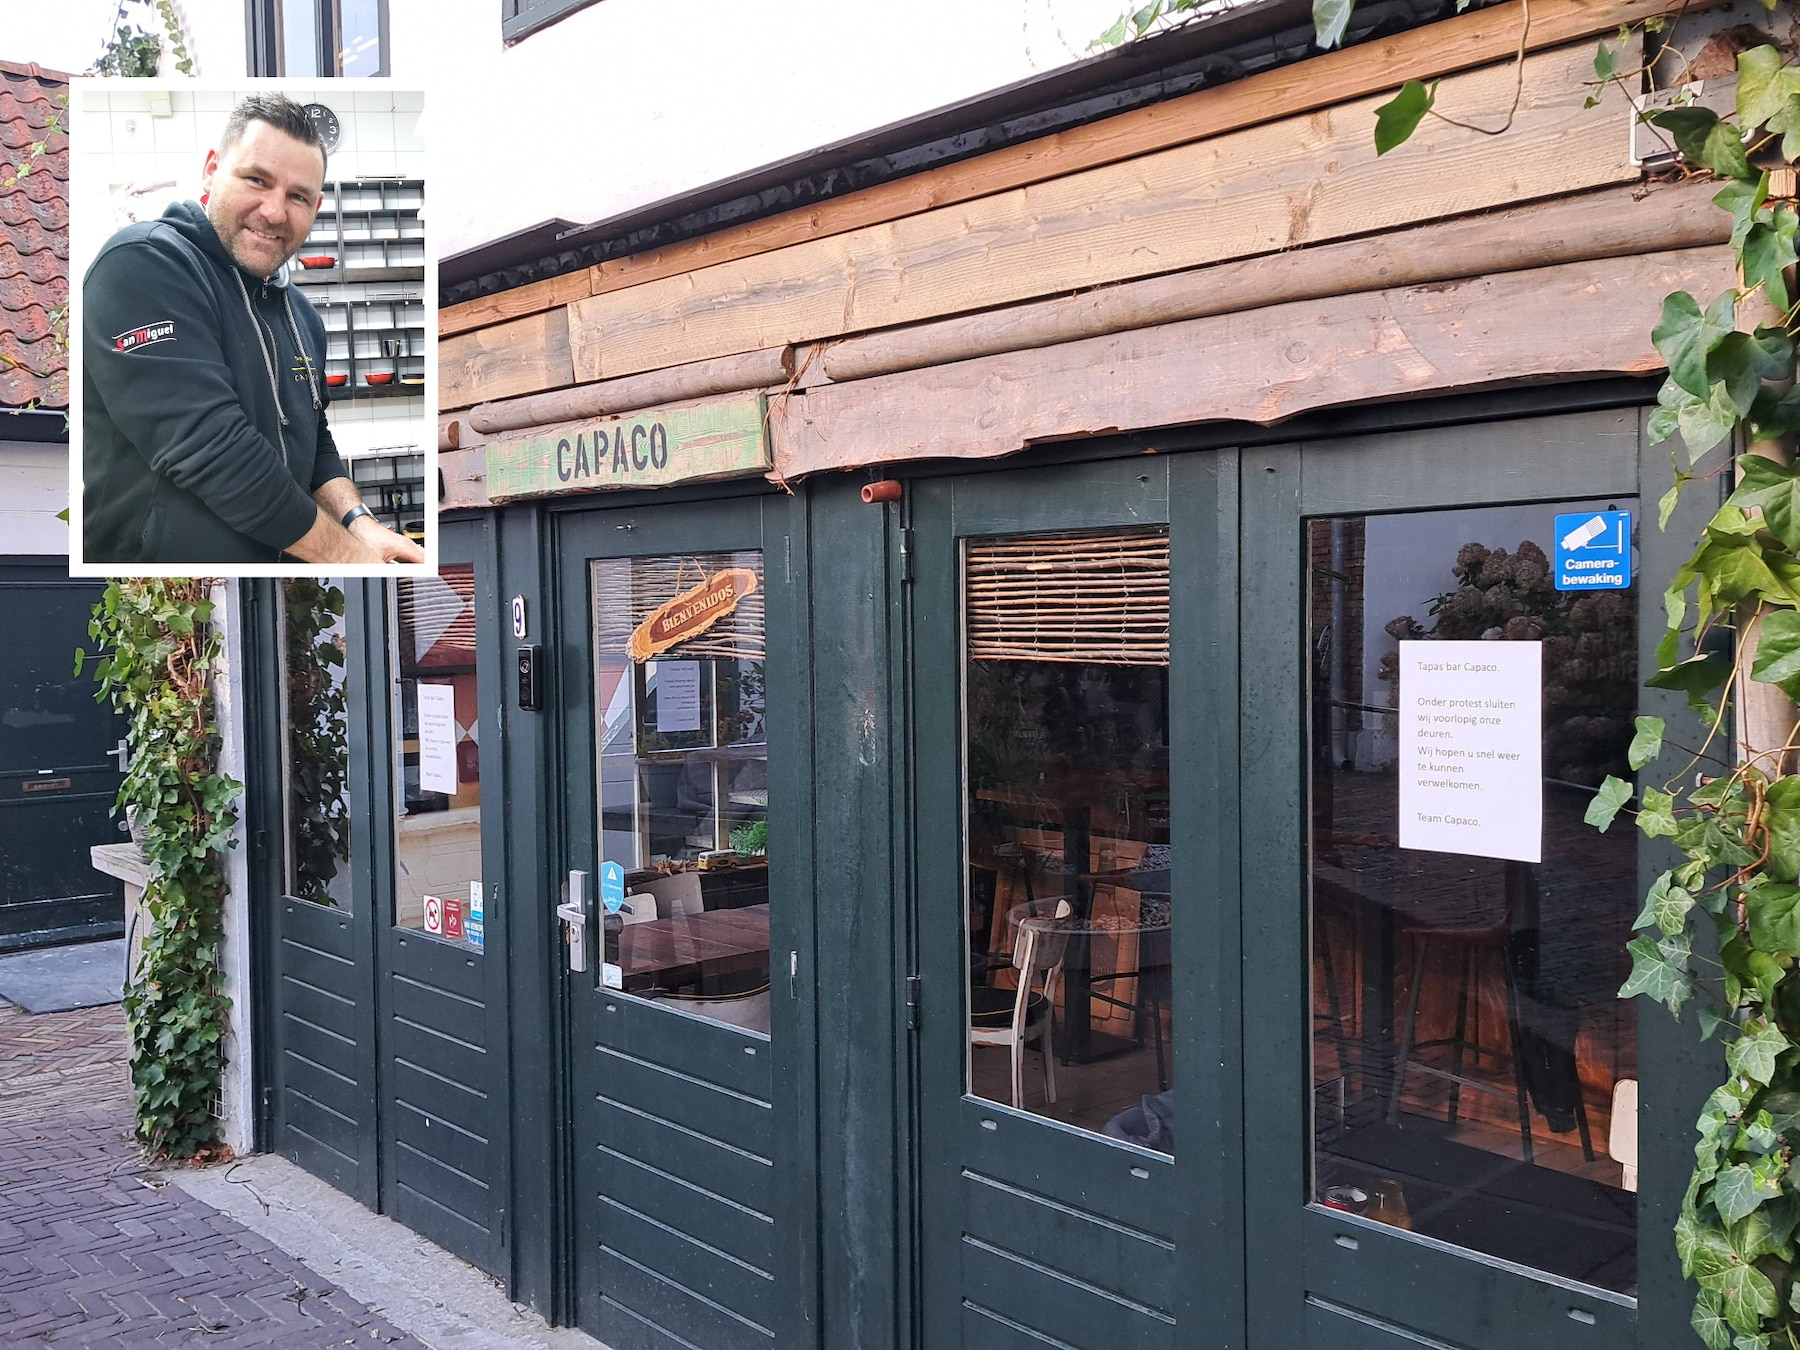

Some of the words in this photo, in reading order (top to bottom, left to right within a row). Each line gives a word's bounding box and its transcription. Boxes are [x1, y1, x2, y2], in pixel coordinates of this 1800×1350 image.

[312, 108, 321, 118] 12
[329, 126, 337, 134] 3
[114, 336, 136, 351] San
[133, 324, 174, 343] Miguel
[557, 422, 668, 483] CAPACO
[1565, 558, 1619, 570] Camera-
[1562, 573, 1623, 585] bewaking
[662, 584, 734, 632] BIENVENIDOS
[514, 602, 522, 634] 9
[1417, 661, 1444, 673] Tapas
[1446, 662, 1461, 671] bar
[1464, 662, 1500, 674] Capaco.
[1417, 697, 1446, 707] Onder
[1449, 699, 1482, 709] protest
[1484, 698, 1516, 709] sluiten
[1417, 713, 1431, 724] wij
[1434, 714, 1477, 726] voorlopig
[1479, 717, 1501, 725] onze
[1417, 728, 1454, 739] deuren.
[1417, 746, 1433, 757] Wij
[1435, 746, 1465, 758] hopen
[1467, 750, 1474, 758] u
[1476, 750, 1495, 759] snel
[1497, 751, 1521, 761] weer
[1417, 762, 1427, 771] te
[1429, 762, 1464, 773] kunnen
[1417, 778, 1483, 791] verwelkomen.
[1416, 812, 1442, 823] Team
[1444, 814, 1481, 827] Capaco.
